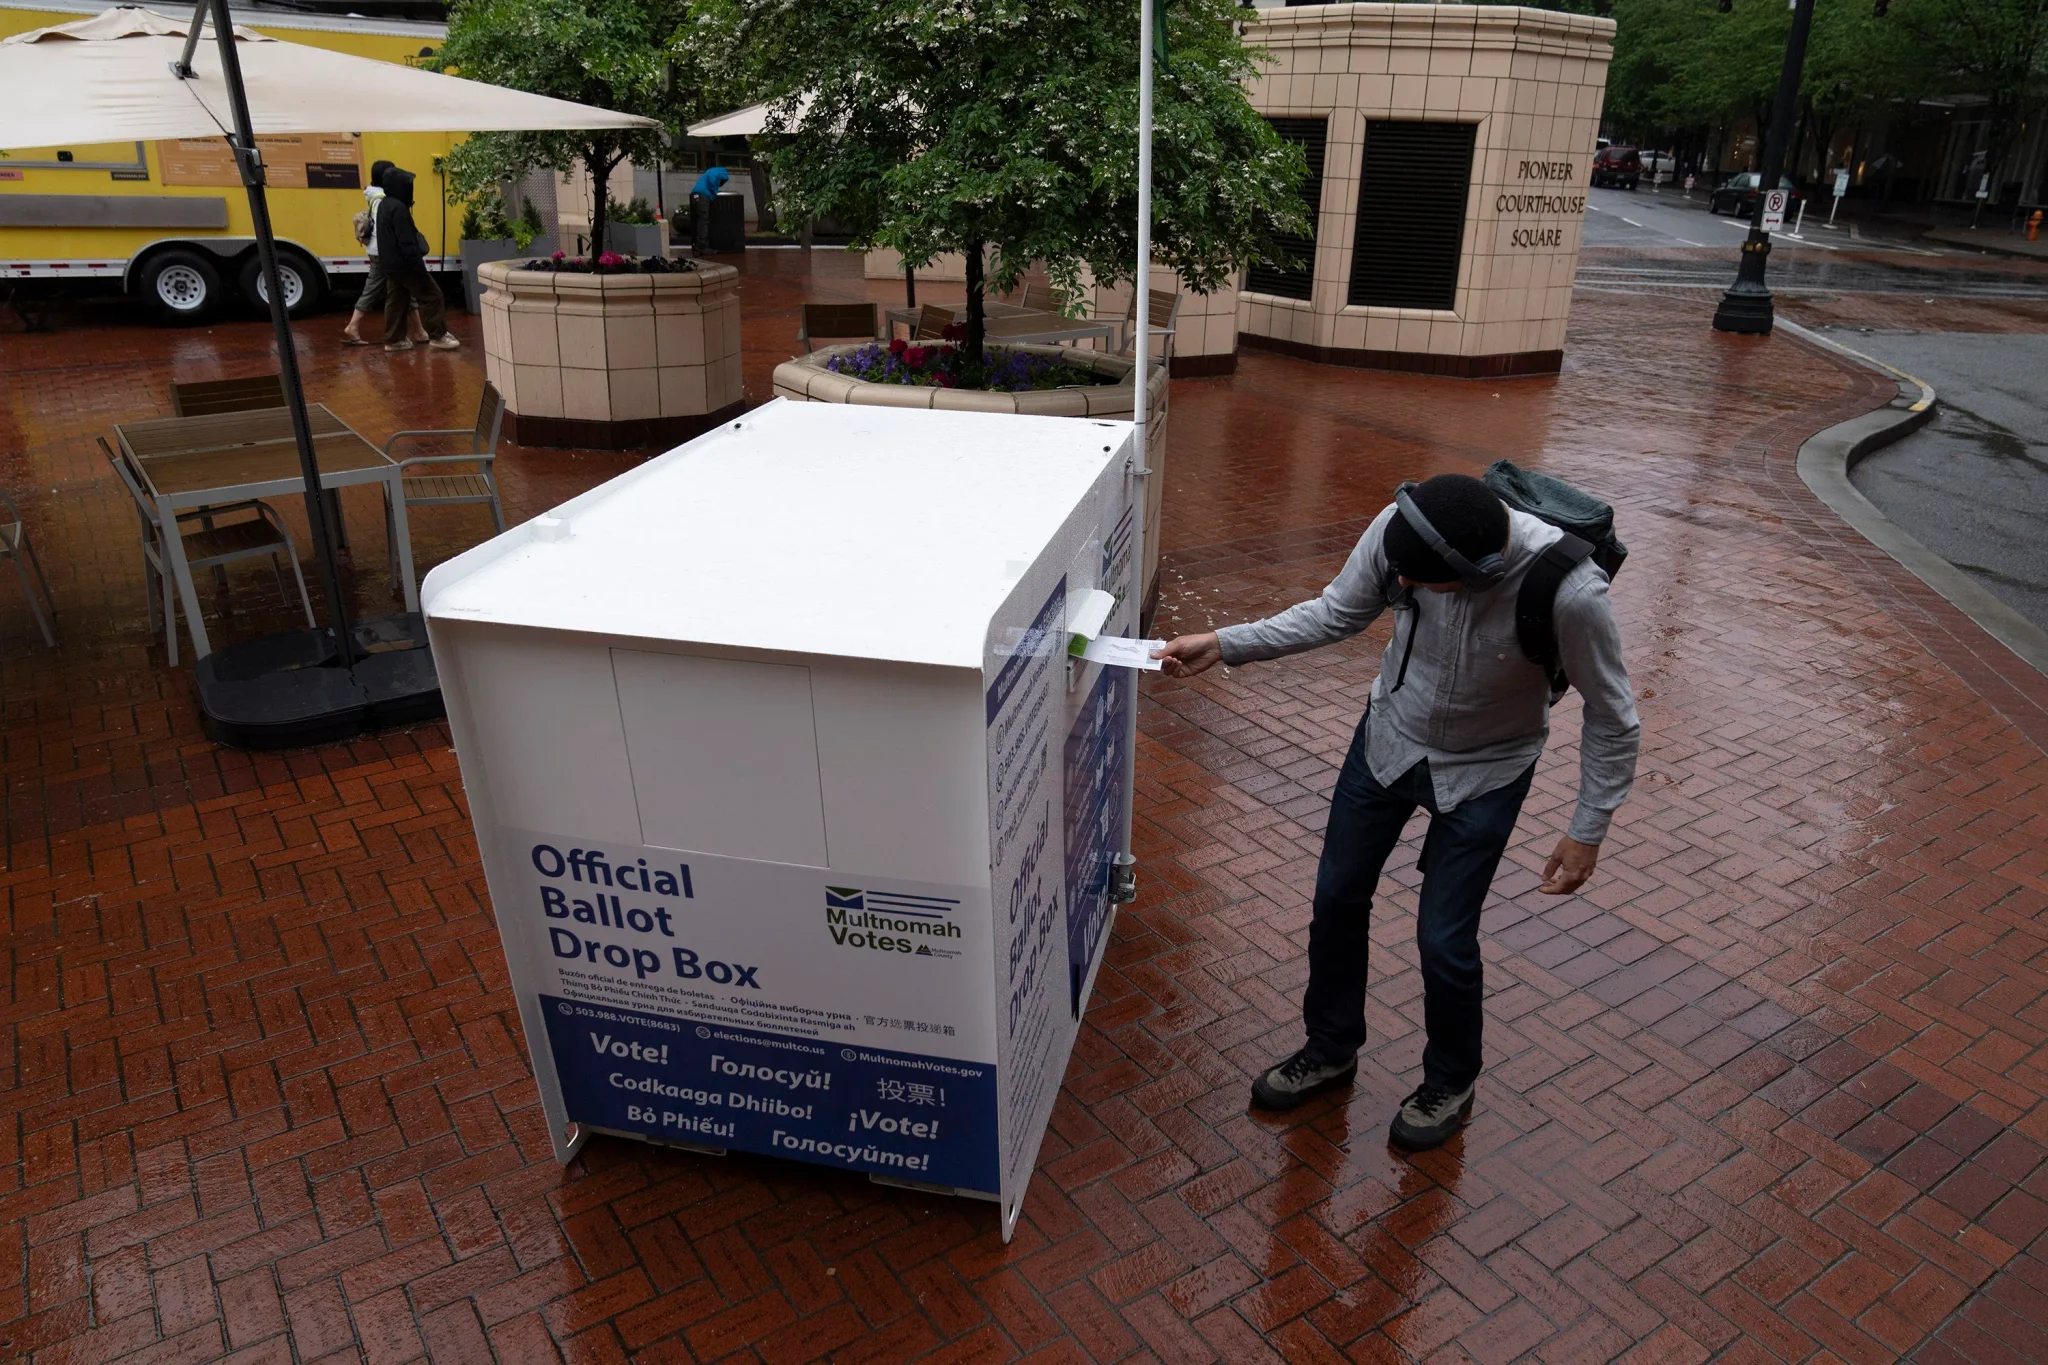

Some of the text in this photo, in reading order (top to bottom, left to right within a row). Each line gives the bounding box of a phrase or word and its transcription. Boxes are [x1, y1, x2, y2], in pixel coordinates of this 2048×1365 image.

[1517, 160, 1573, 180] PIONEER
[1496, 194, 1585, 214] COURTHOUSE
[1511, 228, 1562, 248] SQUARE
[1101, 543, 1132, 592] Multnoma
[531, 844, 694, 898] Official
[1010, 800, 1049, 924] Official
[539, 885, 675, 937] Ballot
[826, 907, 962, 938] Multnomah
[828, 925, 913, 954] Votes
[1010, 875, 1042, 986] Ballot
[548, 926, 762, 989] Drop Box
[1010, 944, 1037, 1041] Drop
[1039, 884, 1060, 957] Box
[558, 968, 715, 1001] Buzón oficial de entrega de boletas
[563, 988, 819, 1036] Официальная урна для избирательных бюллетеней
[575, 1007, 681, 1033] 503.988.VOTE(8683)
[692, 1000, 856, 1031] Sanduuqa Codobixinta Rasmiga ah
[730, 996, 851, 1021] Офіційна виборча урна
[590, 1031, 669, 1065] Vote!
[713, 1030, 826, 1055] elections@multco.us
[710, 1054, 832, 1090] Голосуй!
[859, 1052, 983, 1078] MultnomahVotes.gov
[609, 1072, 813, 1120] Codkaaga Dhiibo!
[627, 1105, 735, 1138] Bỏ Phiếu!
[848, 1109, 940, 1140] ¡Vote!
